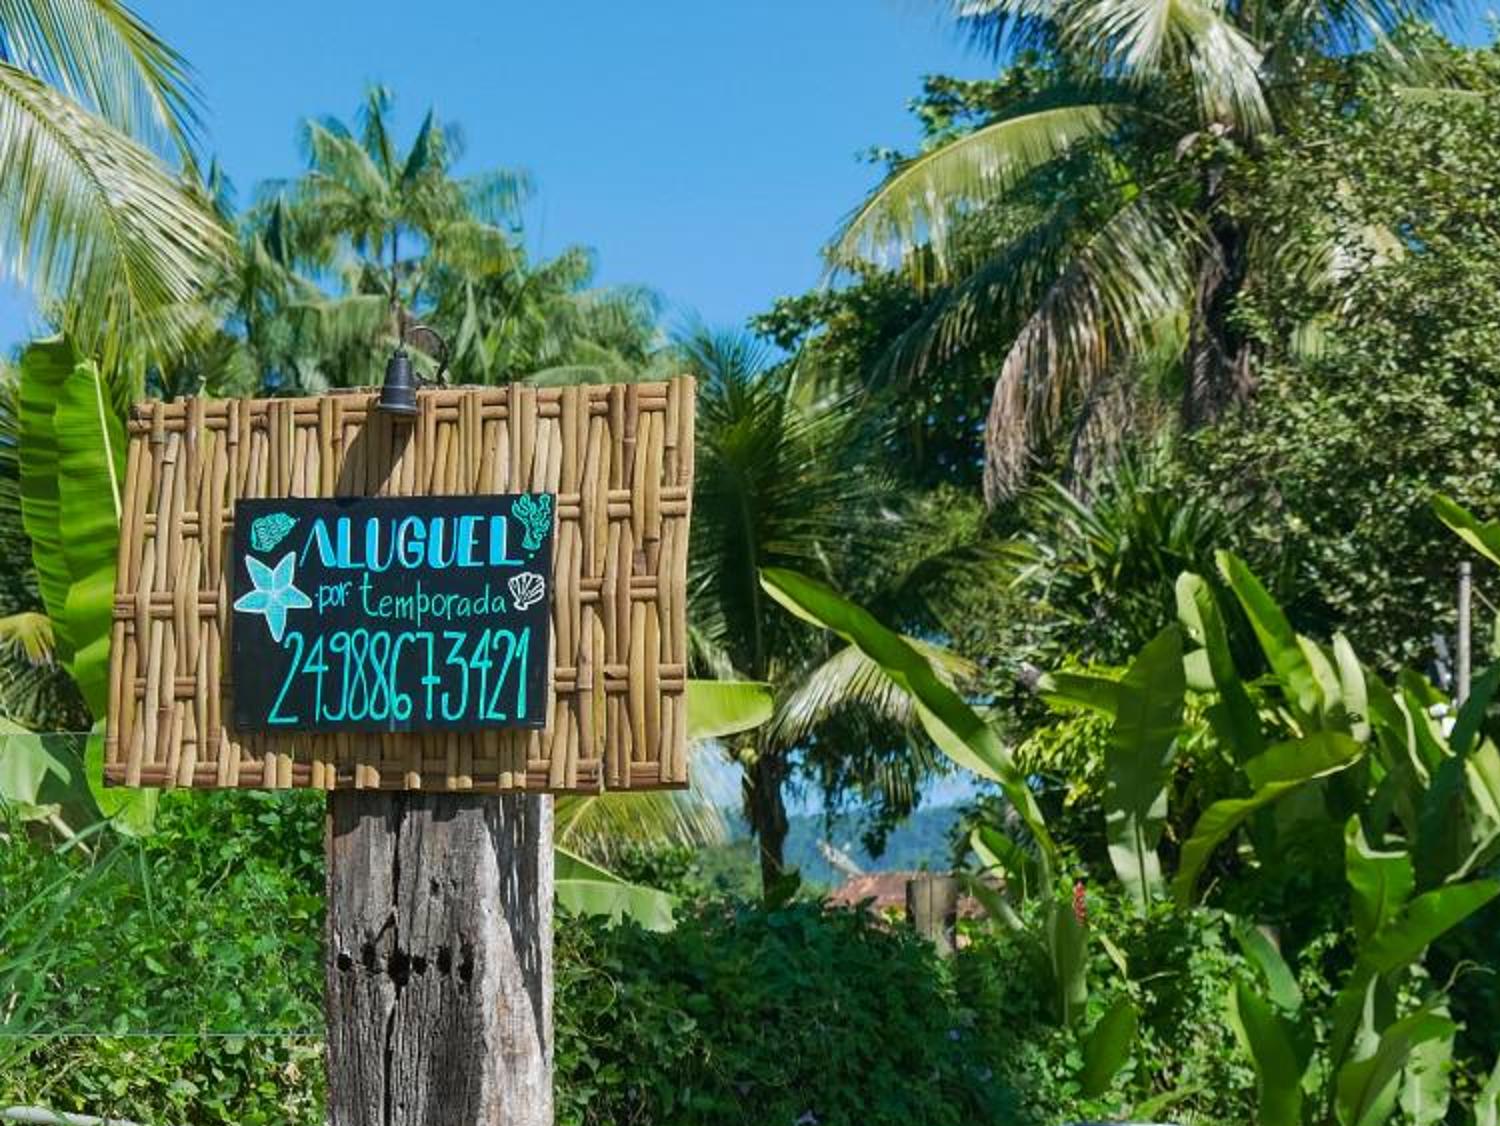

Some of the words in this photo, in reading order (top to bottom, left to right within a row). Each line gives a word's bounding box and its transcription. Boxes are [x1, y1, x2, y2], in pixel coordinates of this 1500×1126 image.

[299, 516, 525, 572] ALUGUEL
[359, 571, 507, 627] temporada
[267, 627, 531, 724] 24988673421
